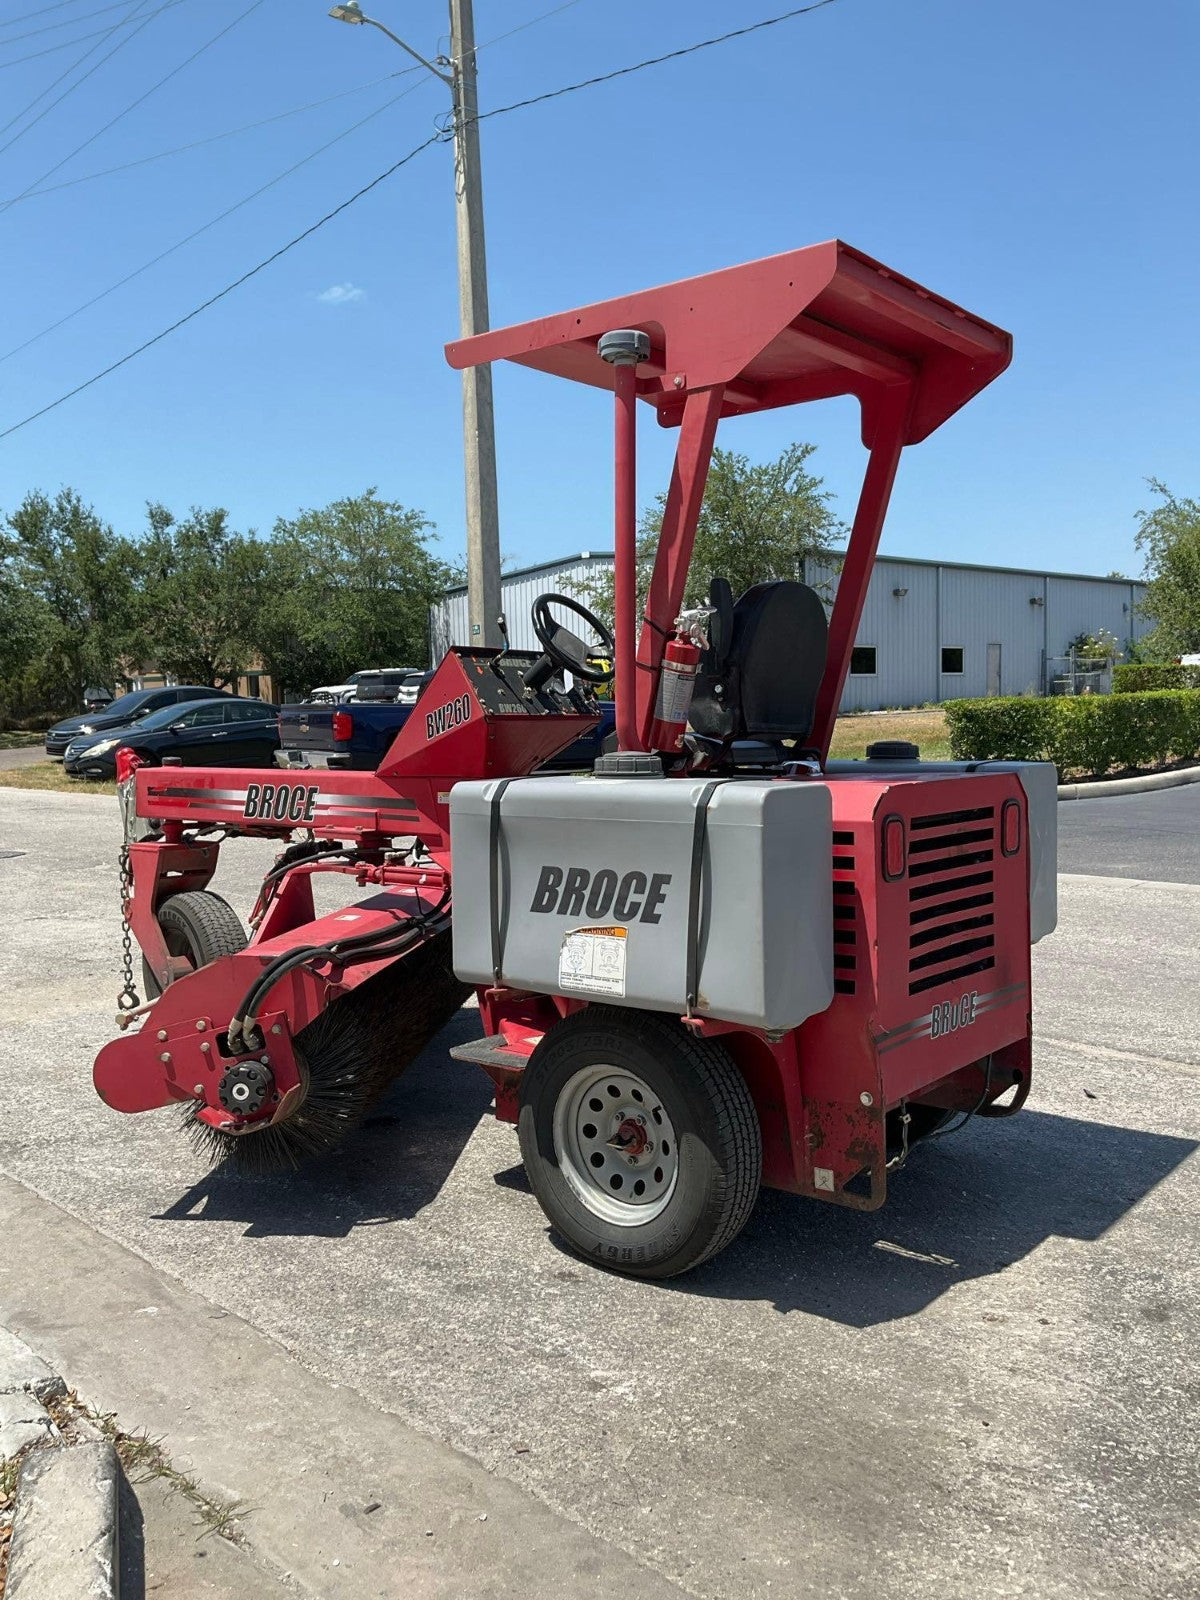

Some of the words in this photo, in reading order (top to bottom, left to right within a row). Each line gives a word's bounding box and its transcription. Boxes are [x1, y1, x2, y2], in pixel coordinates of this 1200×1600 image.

[426, 693, 471, 741] BW260
[243, 783, 320, 822] BROCE
[530, 866, 673, 925] BROCE
